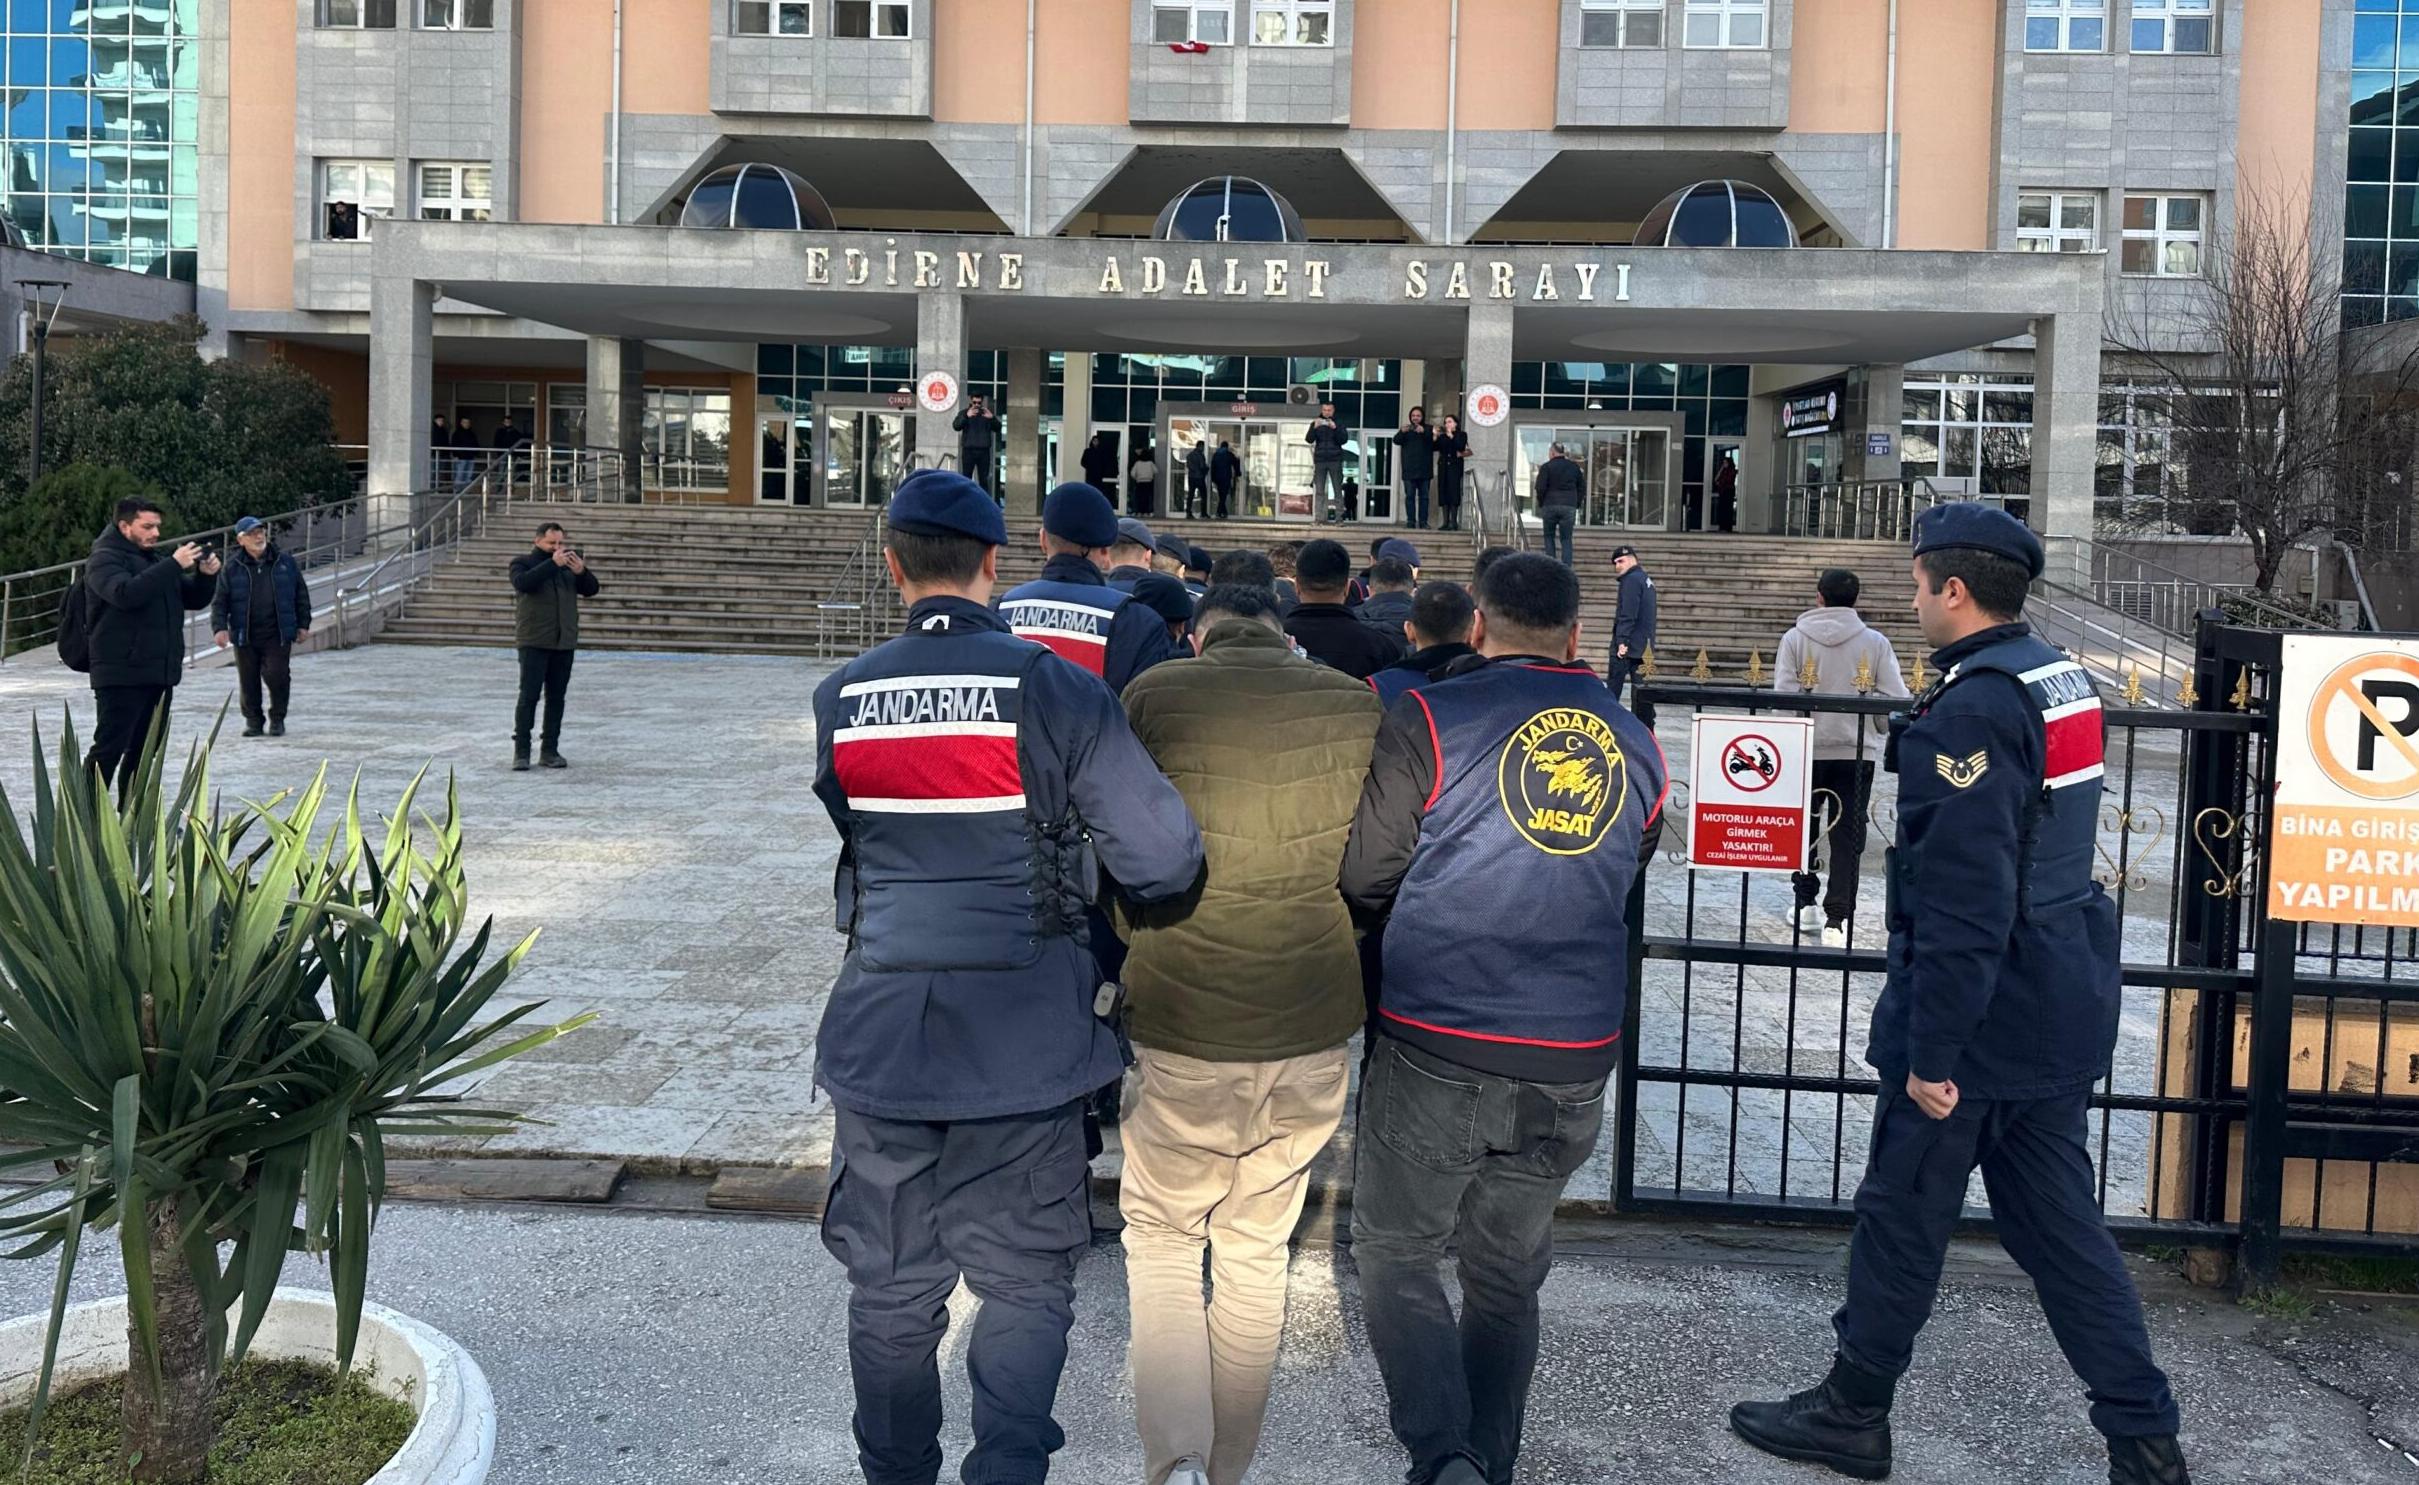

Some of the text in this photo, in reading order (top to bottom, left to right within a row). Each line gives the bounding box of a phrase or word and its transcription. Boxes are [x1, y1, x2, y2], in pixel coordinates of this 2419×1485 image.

[806, 238, 1631, 300] EDİRNE ADALET SARAYI
[1231, 404, 1256, 414] GİRİŞ
[1006, 606, 1098, 635] JANDARMA
[850, 688, 1000, 727] JANDARMA
[1518, 712, 1621, 768] JANDARMA
[1528, 807, 1595, 838] JASAT
[1702, 813, 1795, 827] MOTORLU ARAÇLA
[1727, 826, 1767, 838] GİRMEK
[2280, 813, 2344, 838] BİNA
[1722, 841, 1773, 852] YASAKTIR!
[1727, 852, 1747, 860] İŞLEM
[1748, 854, 1788, 862] UYGULANIR
